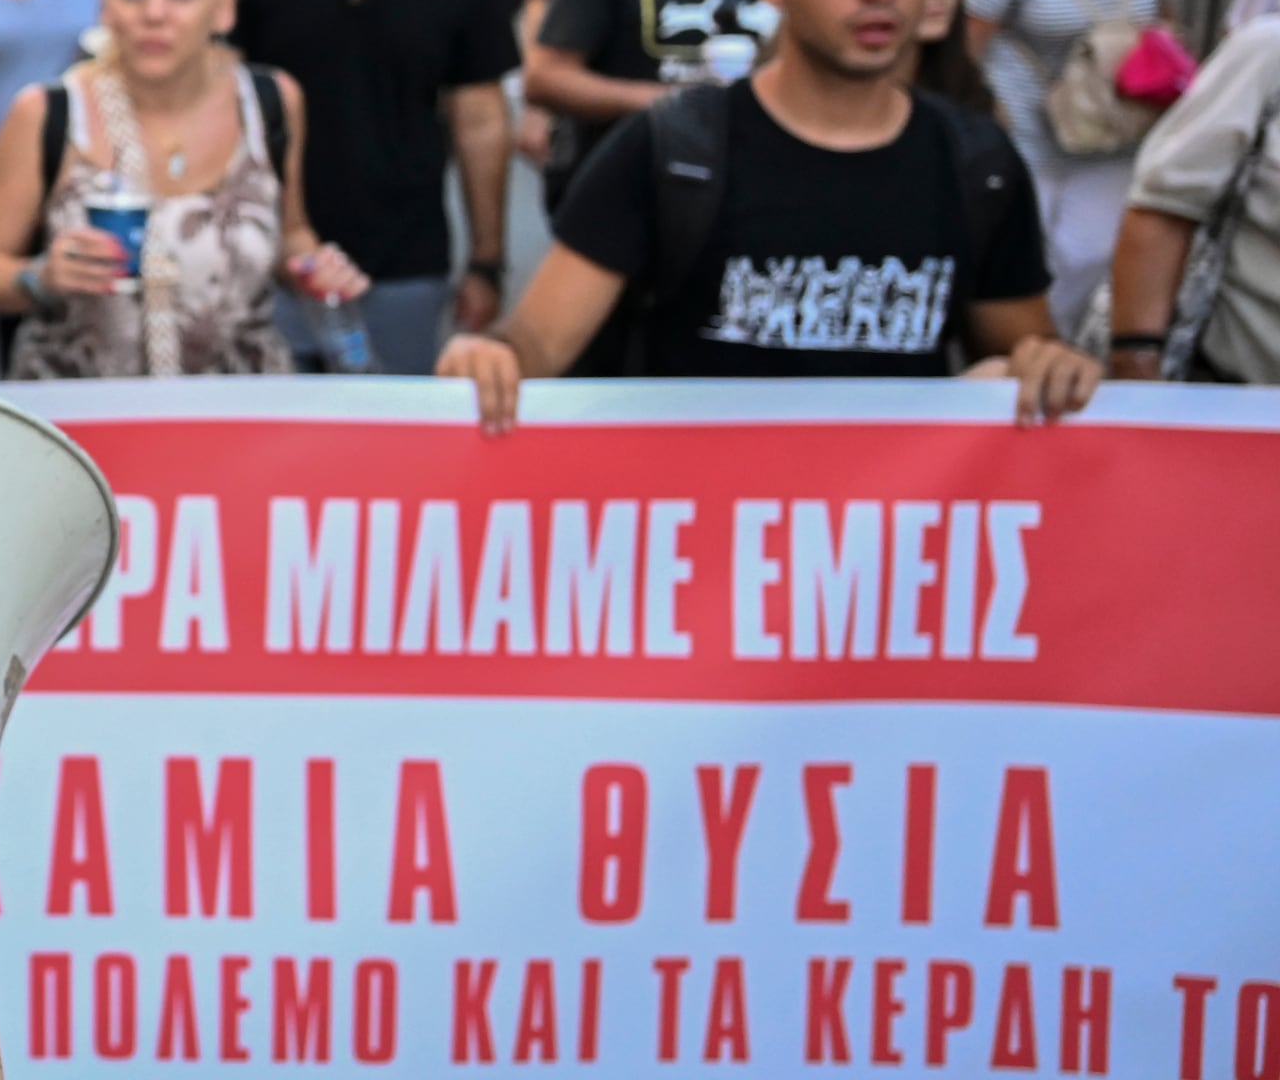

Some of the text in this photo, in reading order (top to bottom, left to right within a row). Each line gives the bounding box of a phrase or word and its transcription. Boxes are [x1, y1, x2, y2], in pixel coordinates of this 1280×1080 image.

[55, 494, 1041, 659] ΡΑ ΜΙΛΑΜΕ ΕΜΕΙΣ
[579, 762, 1060, 930] ΘΥΣΙΑ
[29, 952, 399, 1065] ΠΟΛΕΜΟ
[452, 959, 602, 1064] ΚΑΙ
[653, 957, 749, 1062] ΤΑ
[806, 958, 1111, 1076] ΚΕΡΔΗ
